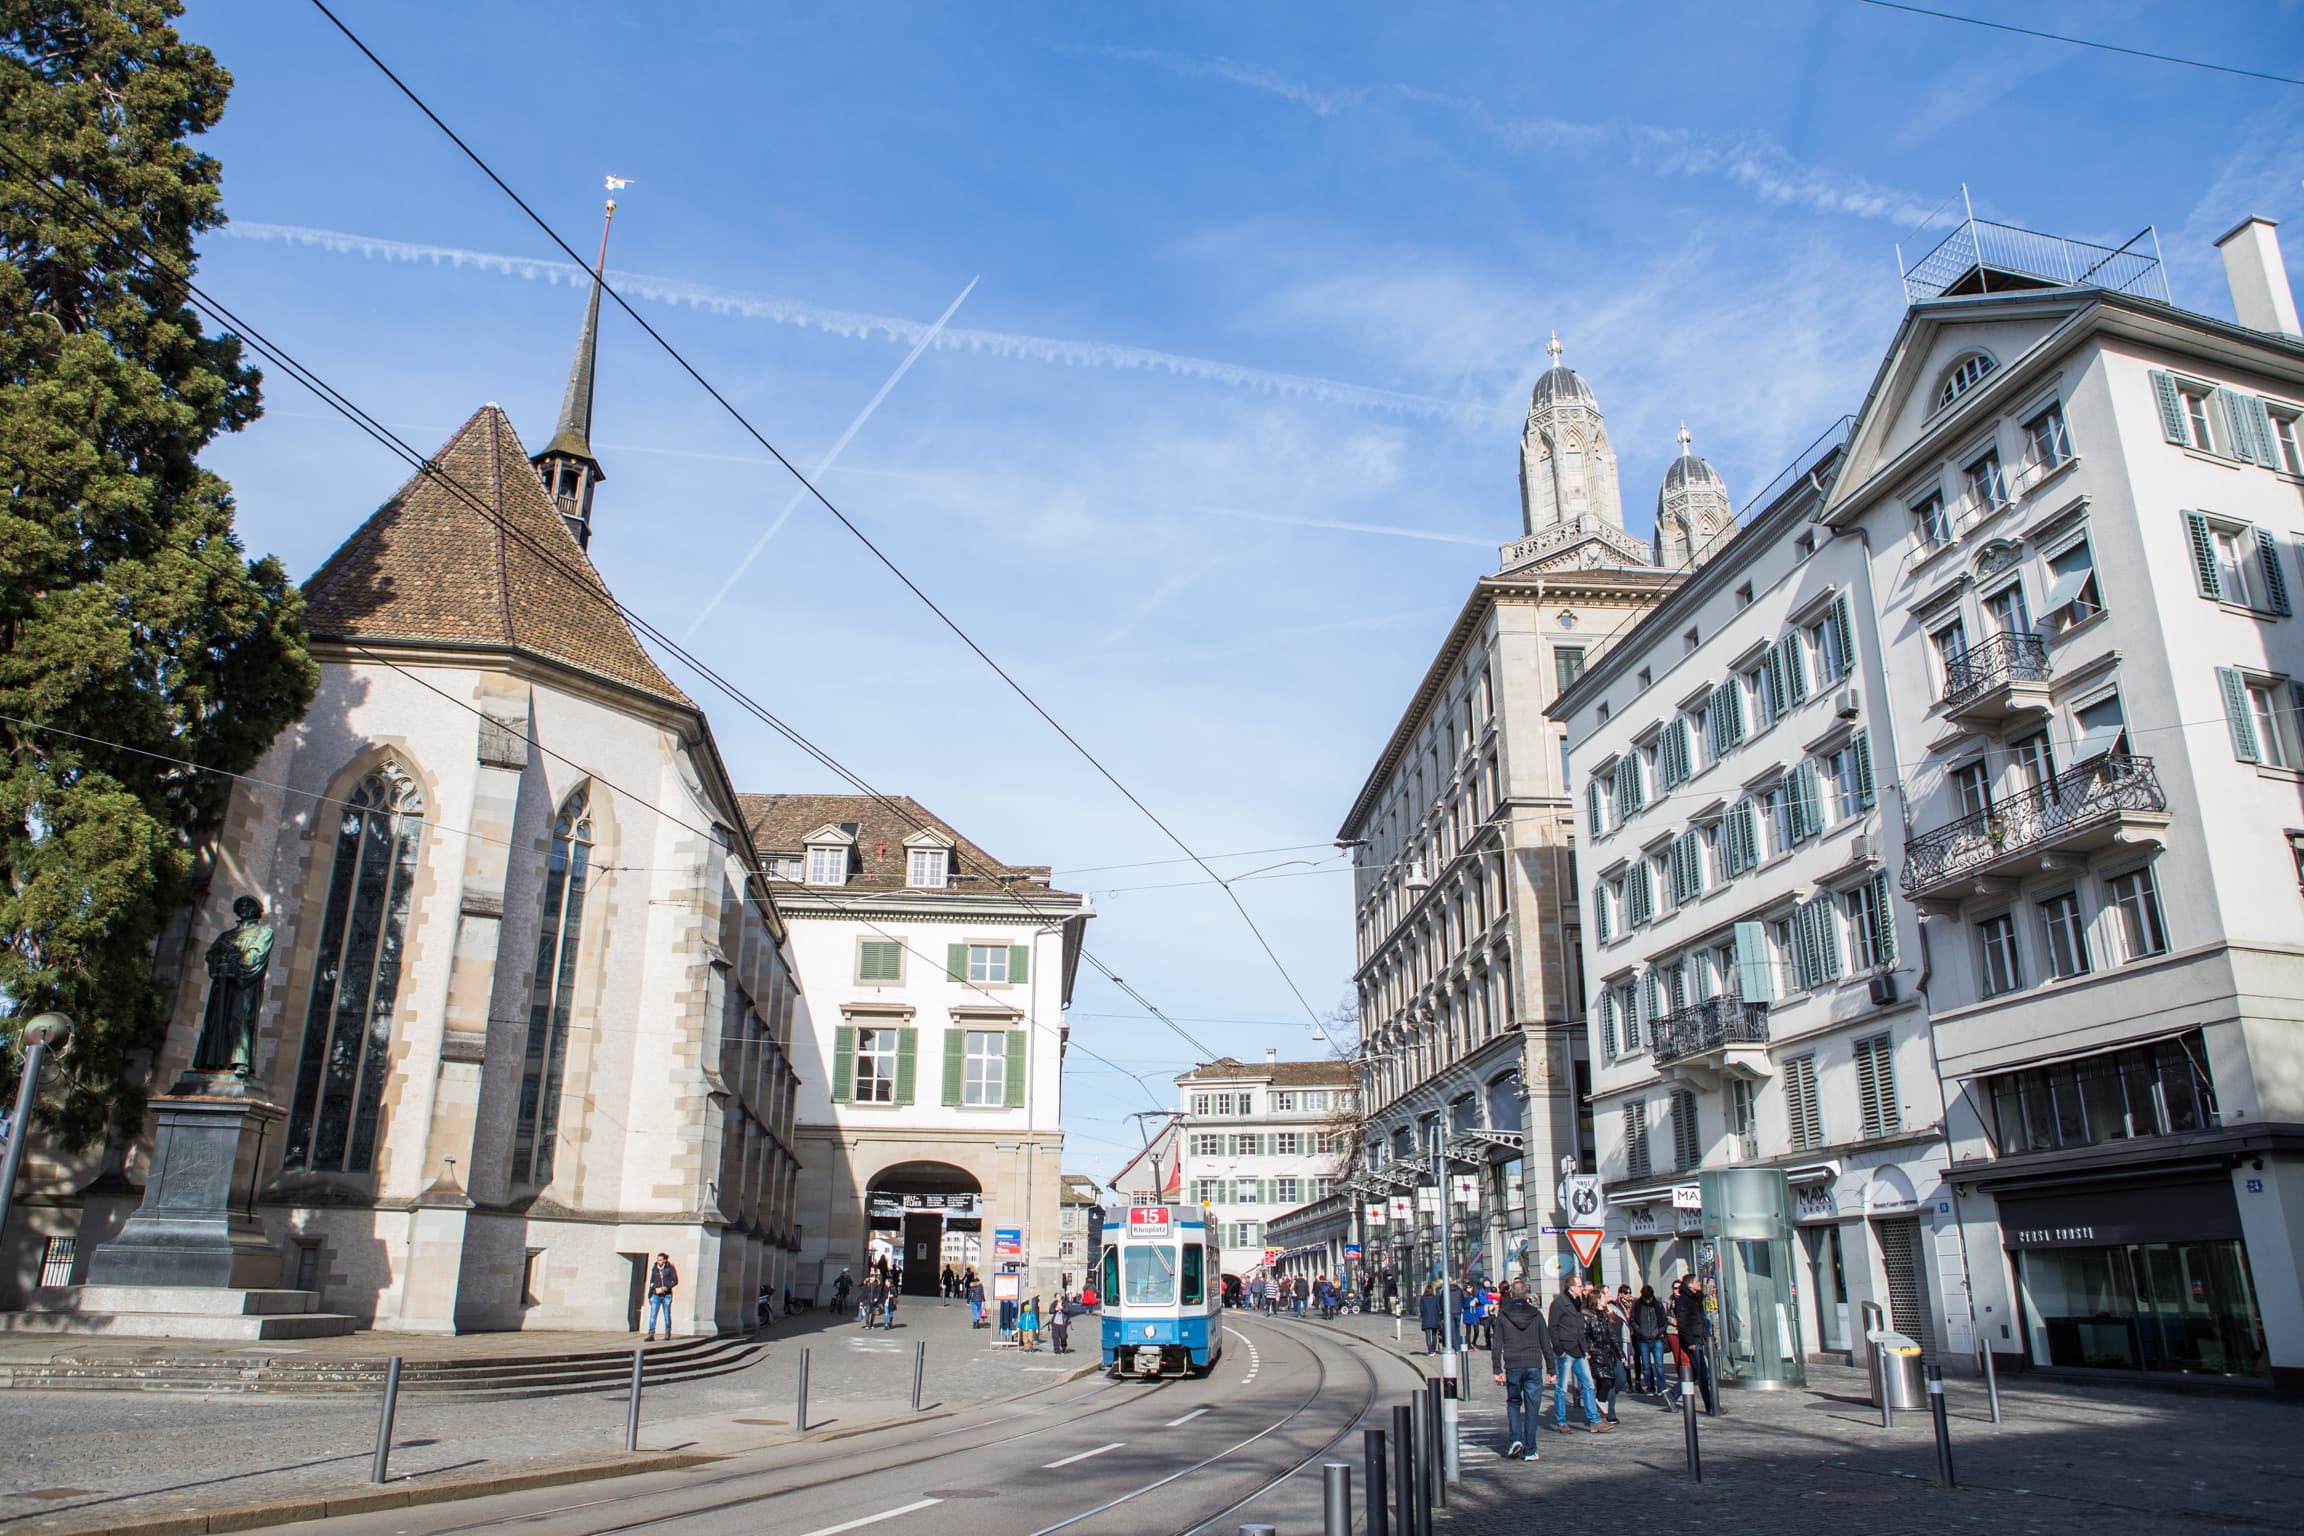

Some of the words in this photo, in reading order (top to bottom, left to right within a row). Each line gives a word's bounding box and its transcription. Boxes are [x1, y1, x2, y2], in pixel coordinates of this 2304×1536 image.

[1677, 1190, 1701, 1200] MA
[1799, 1184, 1831, 1204] MAX
[1140, 1209, 1159, 1223] 15
